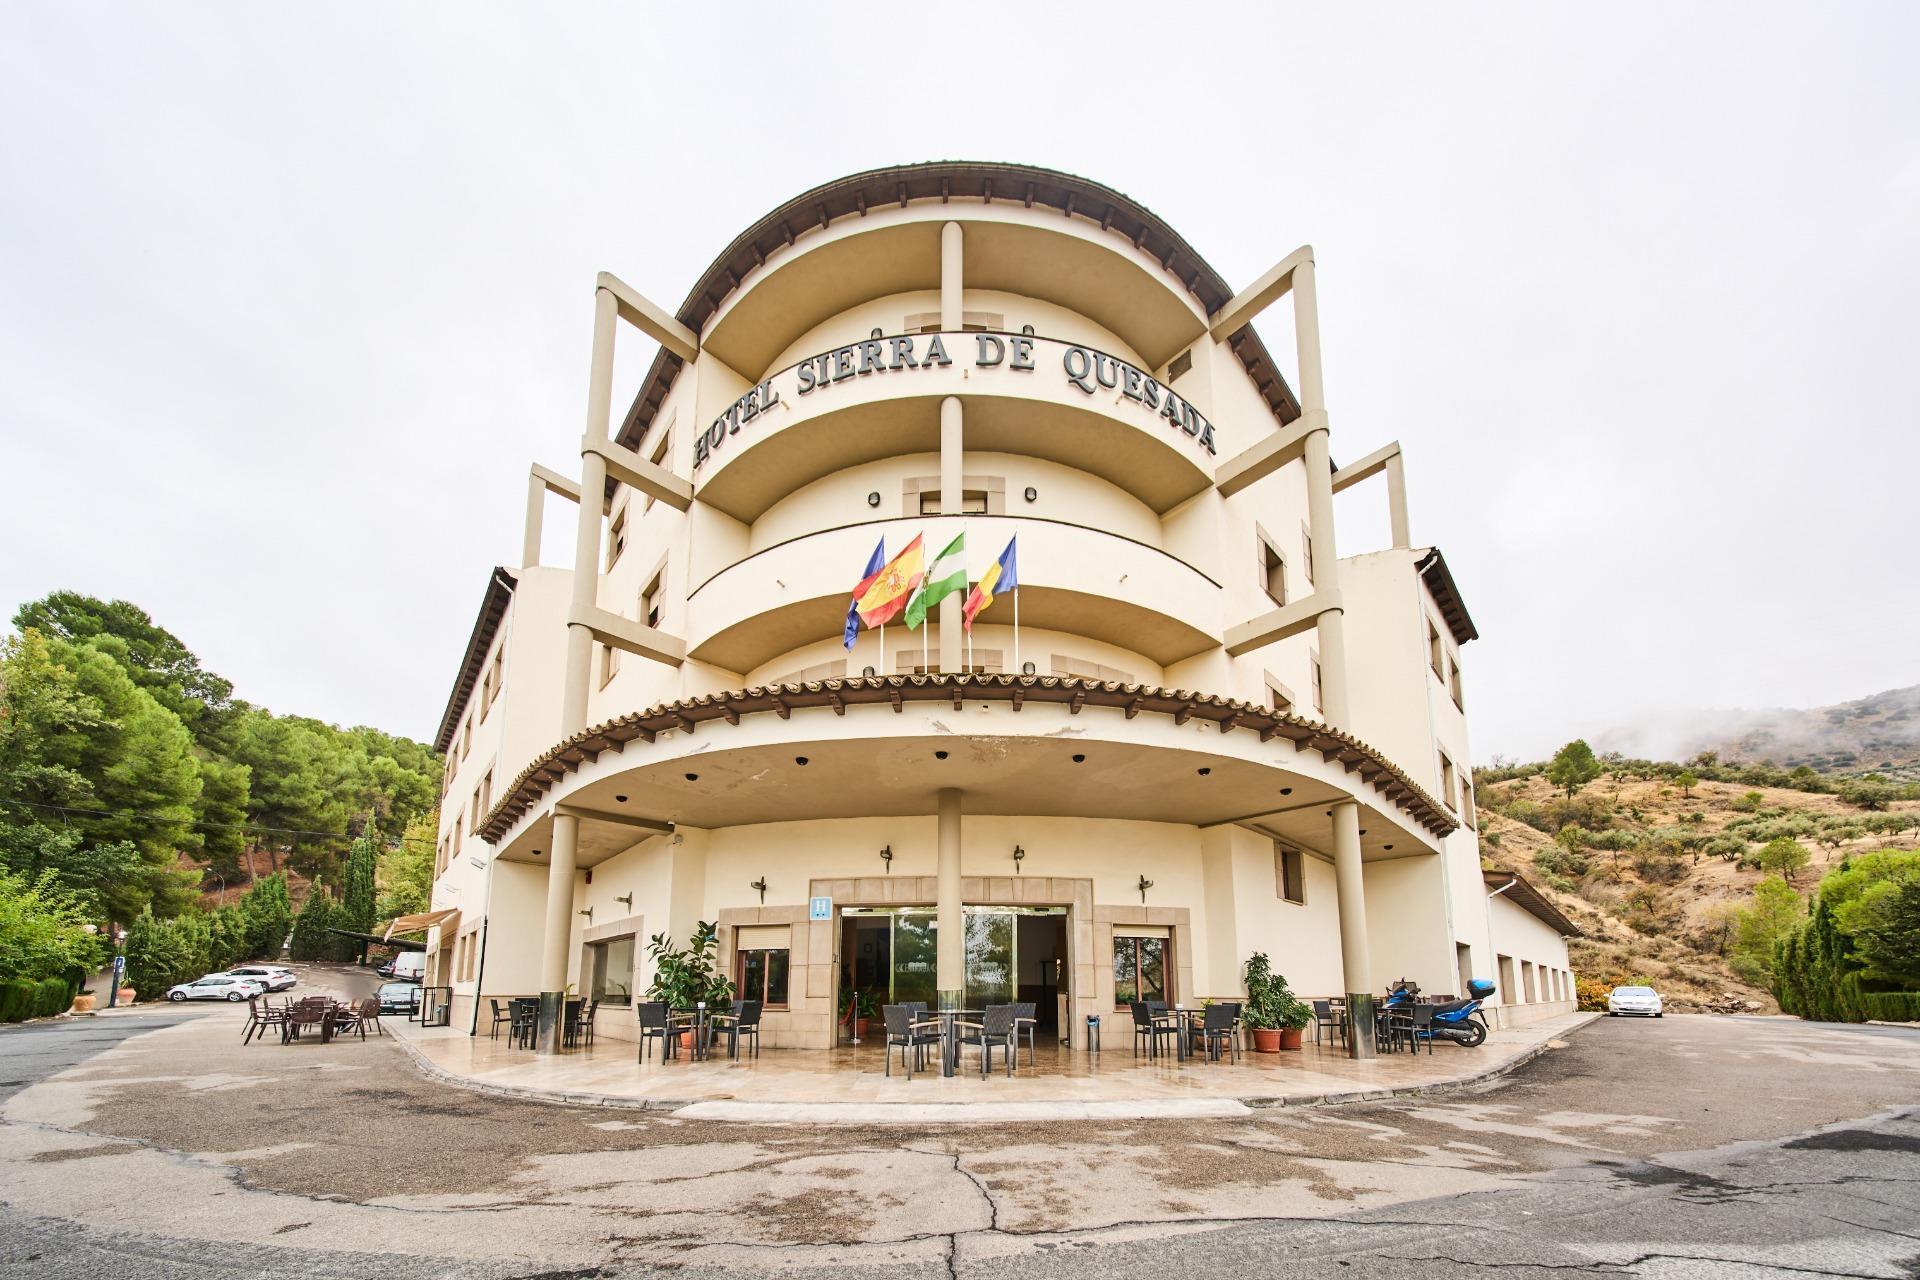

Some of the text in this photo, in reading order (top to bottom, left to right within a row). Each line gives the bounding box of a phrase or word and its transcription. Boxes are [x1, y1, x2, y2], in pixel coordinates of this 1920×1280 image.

[692, 333, 1217, 469] HOTEL SIERRA DE QUESADA
[815, 899, 826, 912] H
